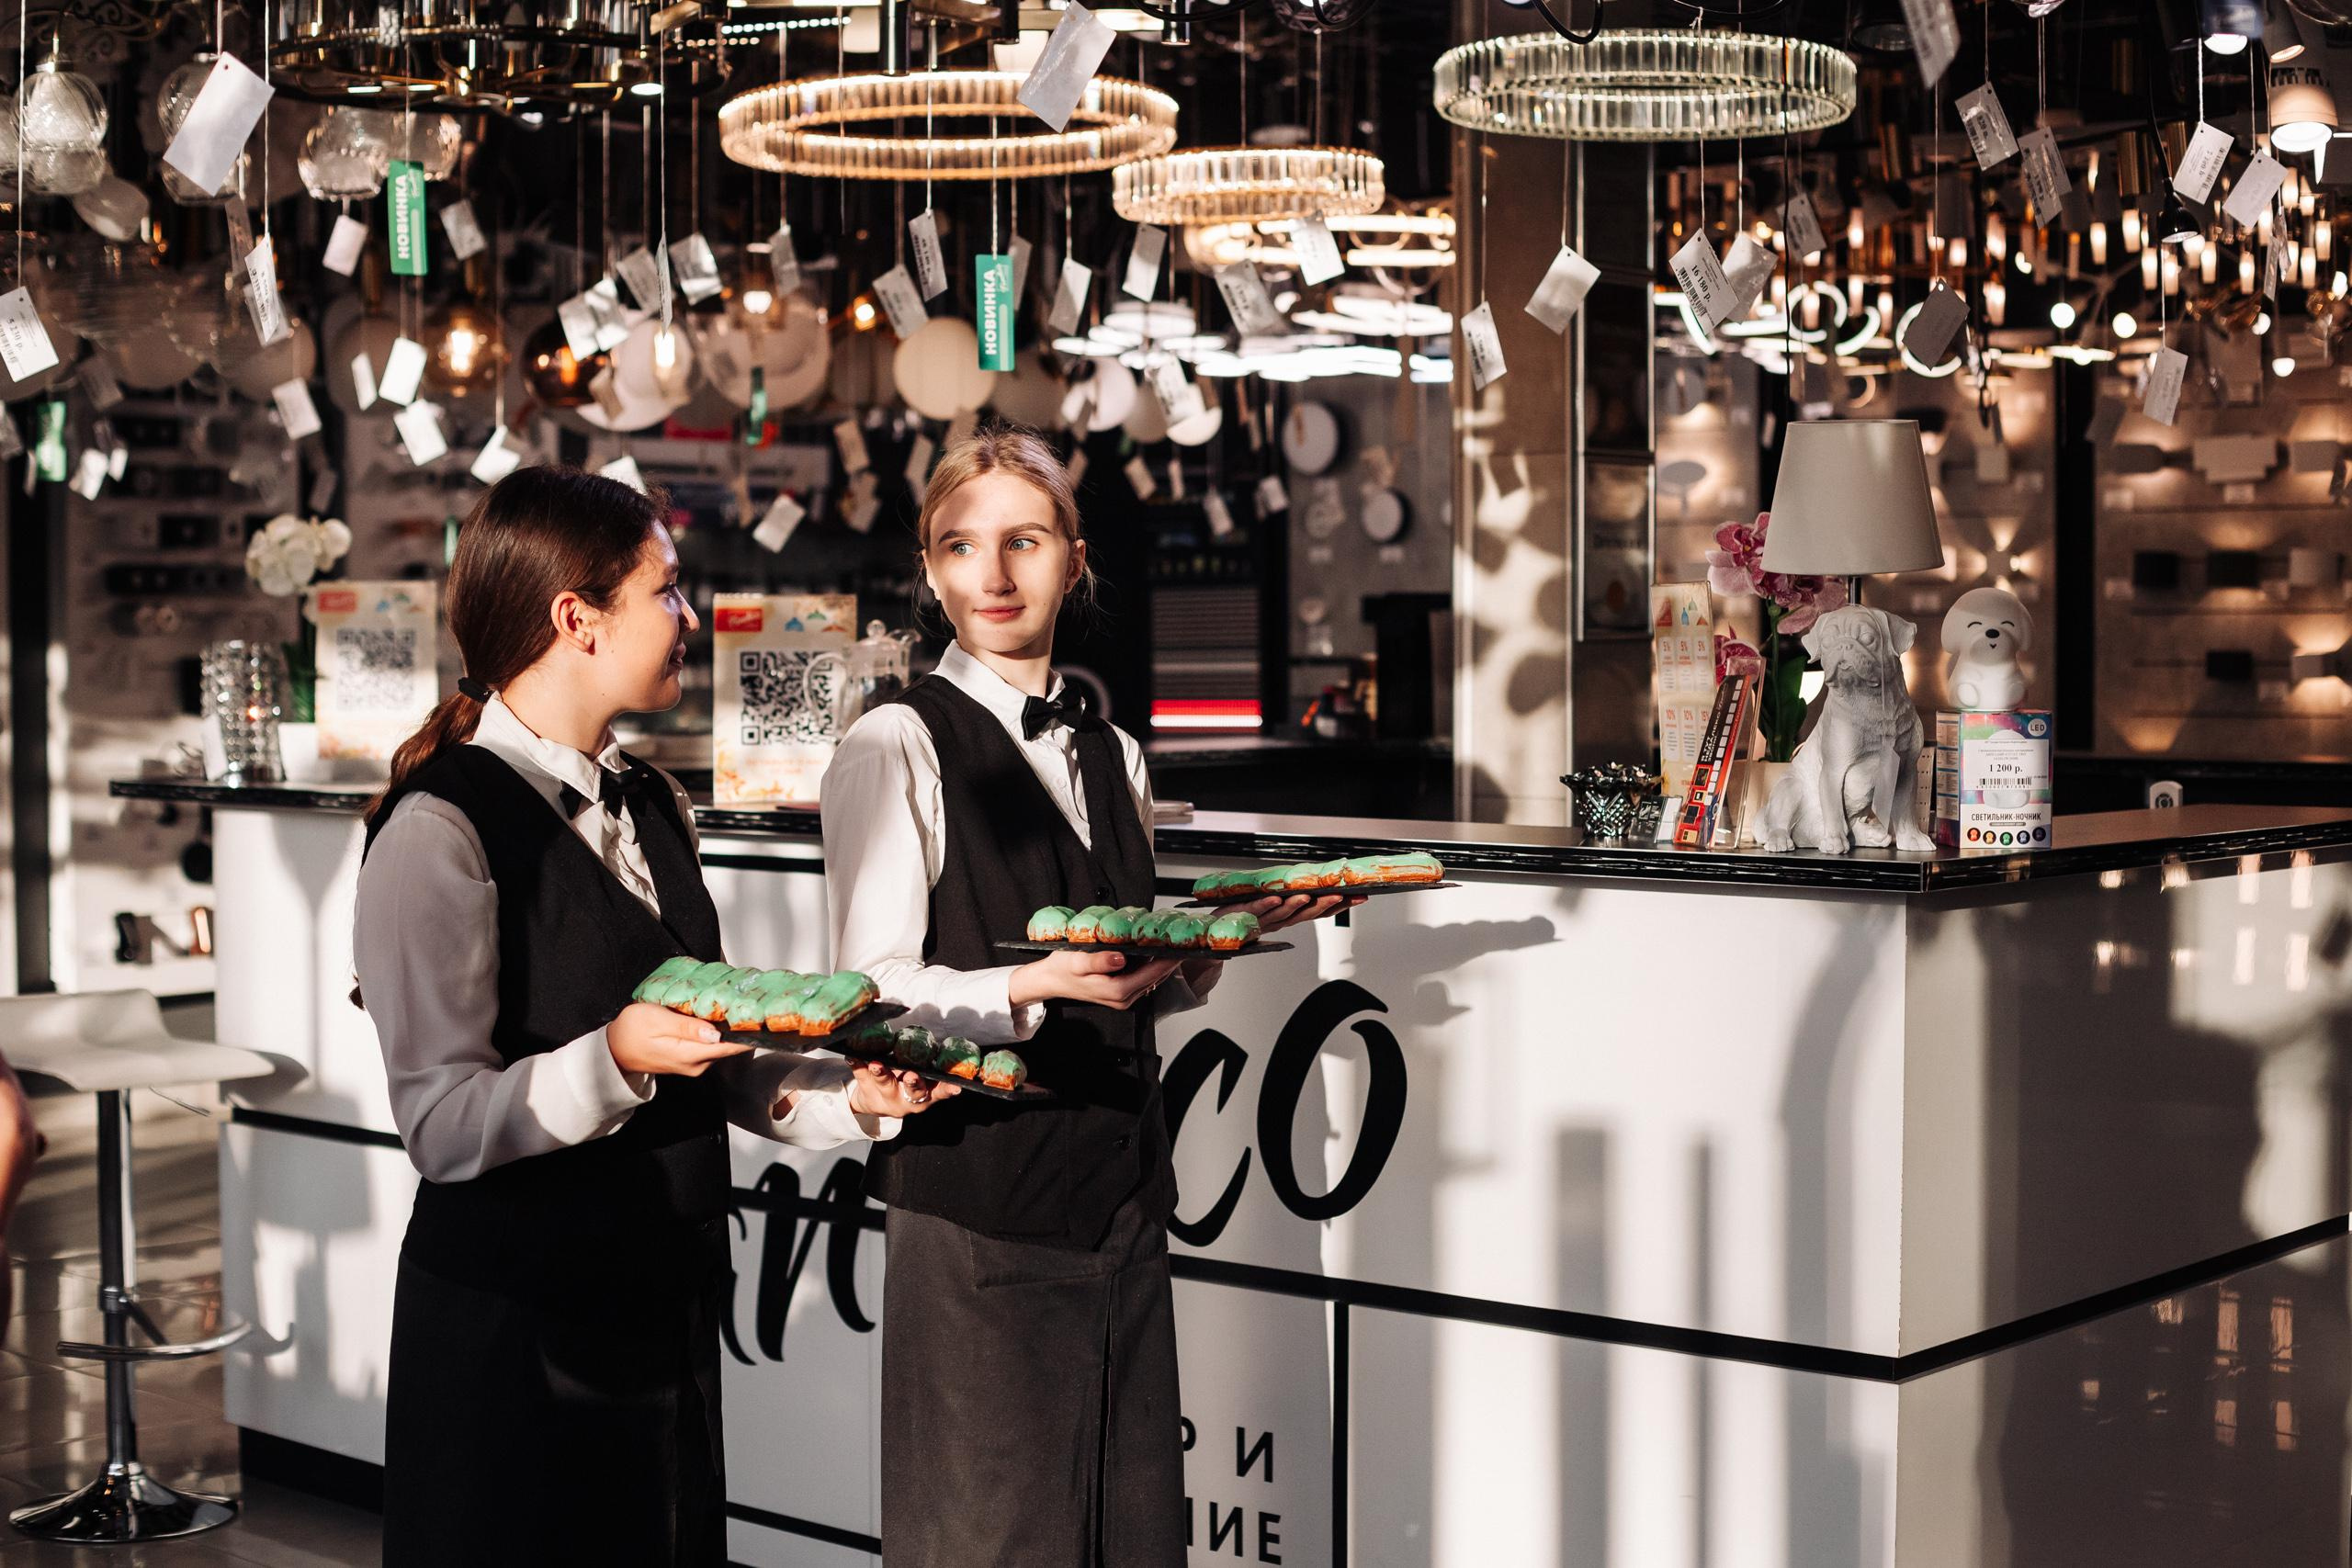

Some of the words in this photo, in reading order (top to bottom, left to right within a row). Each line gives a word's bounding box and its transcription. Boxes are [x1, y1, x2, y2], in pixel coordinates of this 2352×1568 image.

[395, 175, 410, 259] НОВИНКА
[1691, 265, 1700, 276] 16
[1697, 276, 1708, 293] 180
[1703, 293, 1711, 302] р.
[983, 269, 997, 355] НОВИНКА
[1989, 763, 1994, 772] 1
[1996, 763, 2012, 773] 200
[2015, 765, 2023, 773] р.
[1971, 813, 2041, 821] СВЕТИЛЬНИК-НОЧНИК
[1236, 1427, 1273, 1483] И
